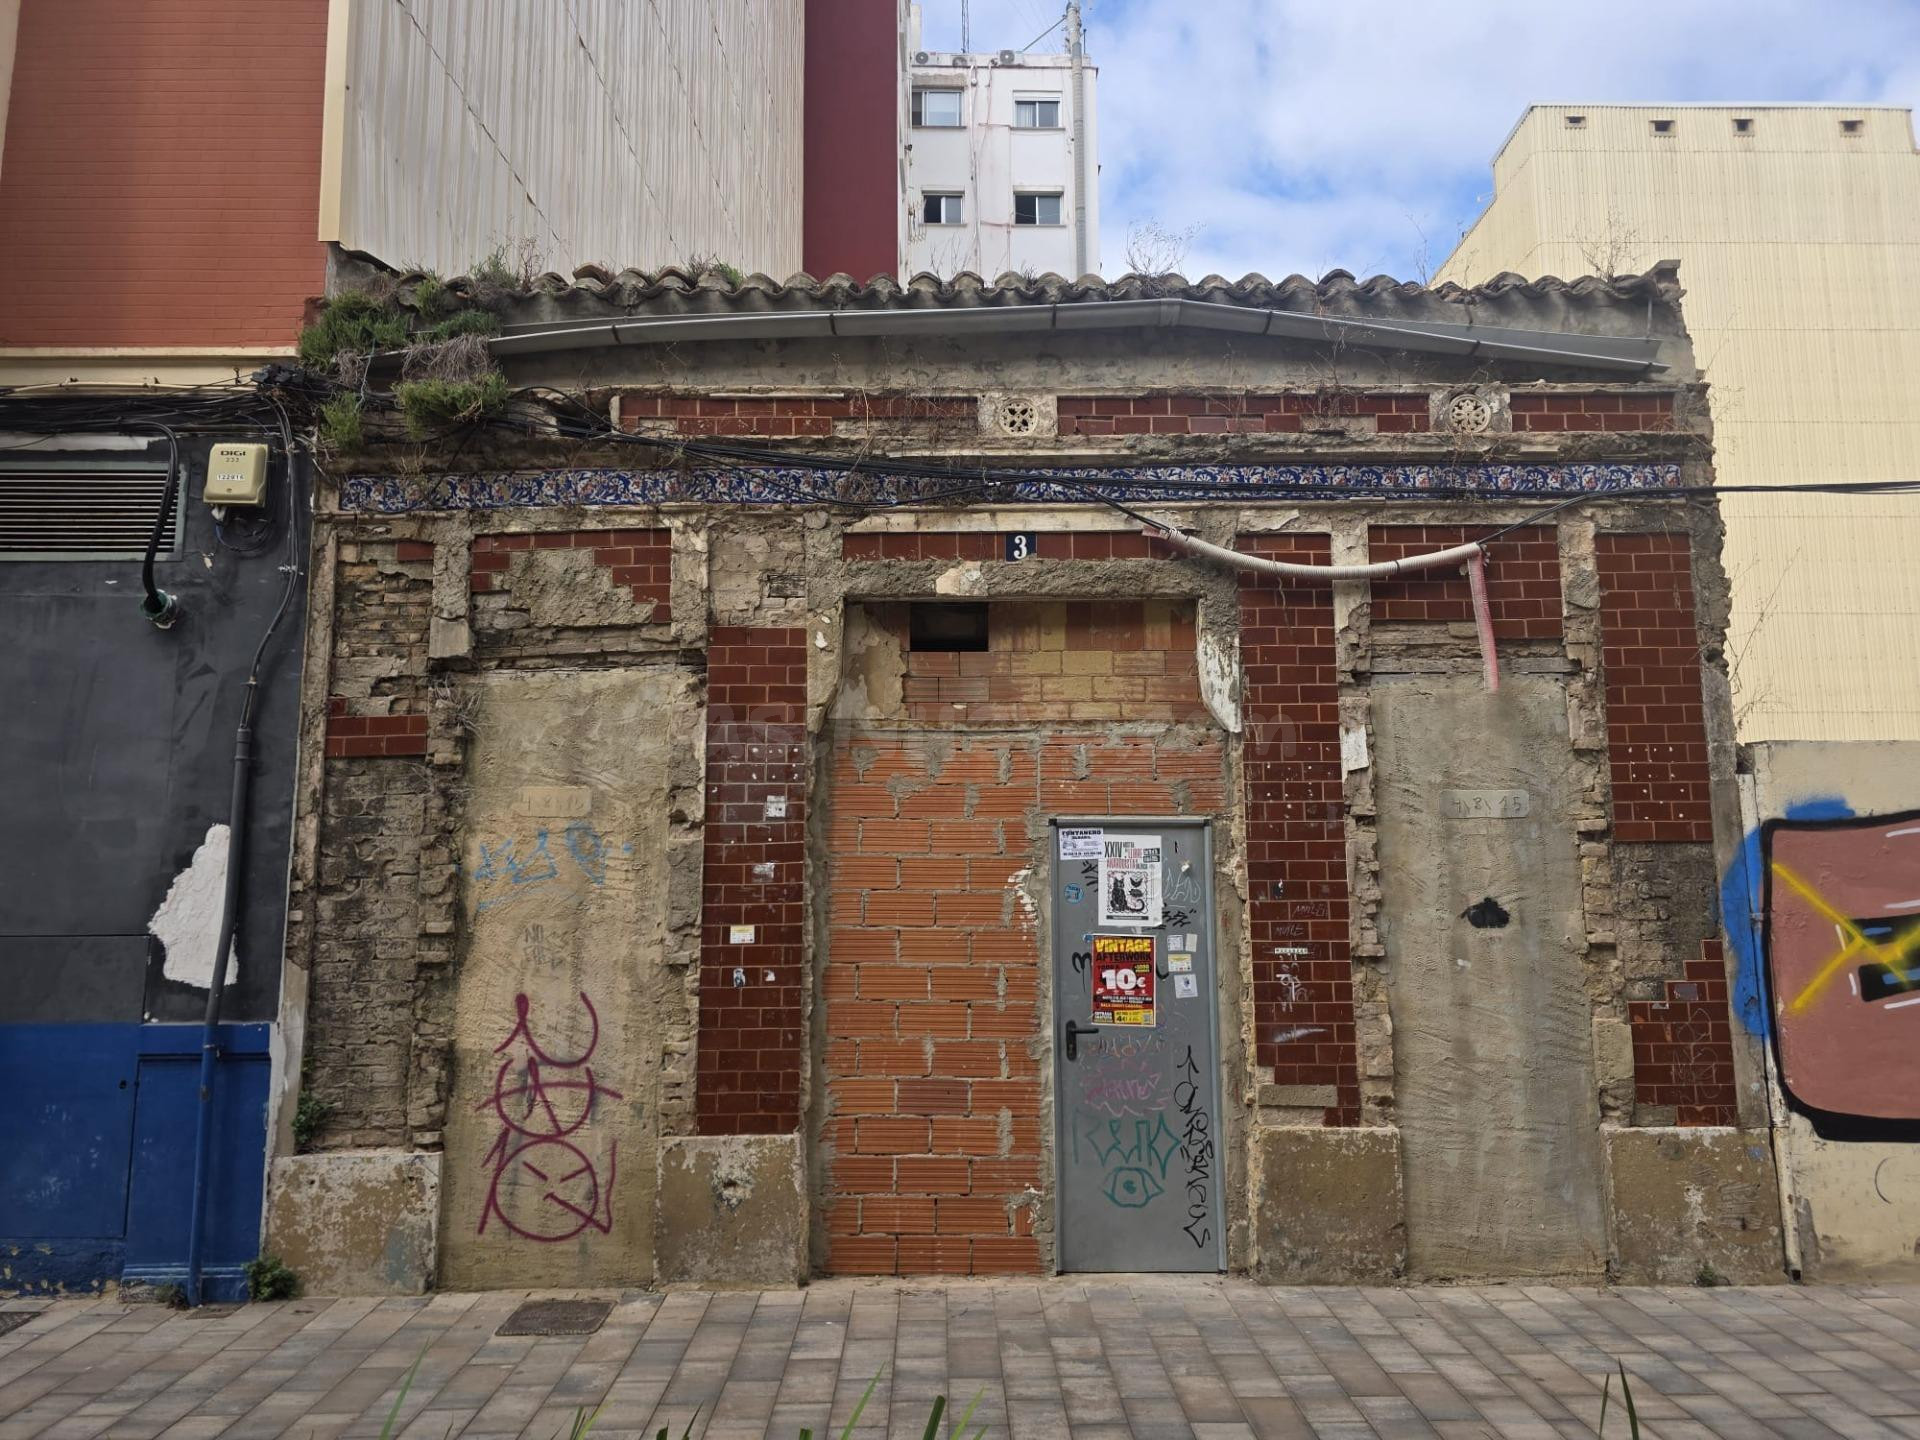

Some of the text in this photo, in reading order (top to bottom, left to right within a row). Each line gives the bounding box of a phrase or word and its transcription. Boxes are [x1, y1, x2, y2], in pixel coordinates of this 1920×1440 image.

[1013, 535, 1028, 559] 3
[1105, 841, 1122, 858] XXIV
[1095, 939, 1152, 952] VINTAGE
[1096, 952, 1151, 962] AFTERWORK
[1101, 968, 1147, 990] 10€
